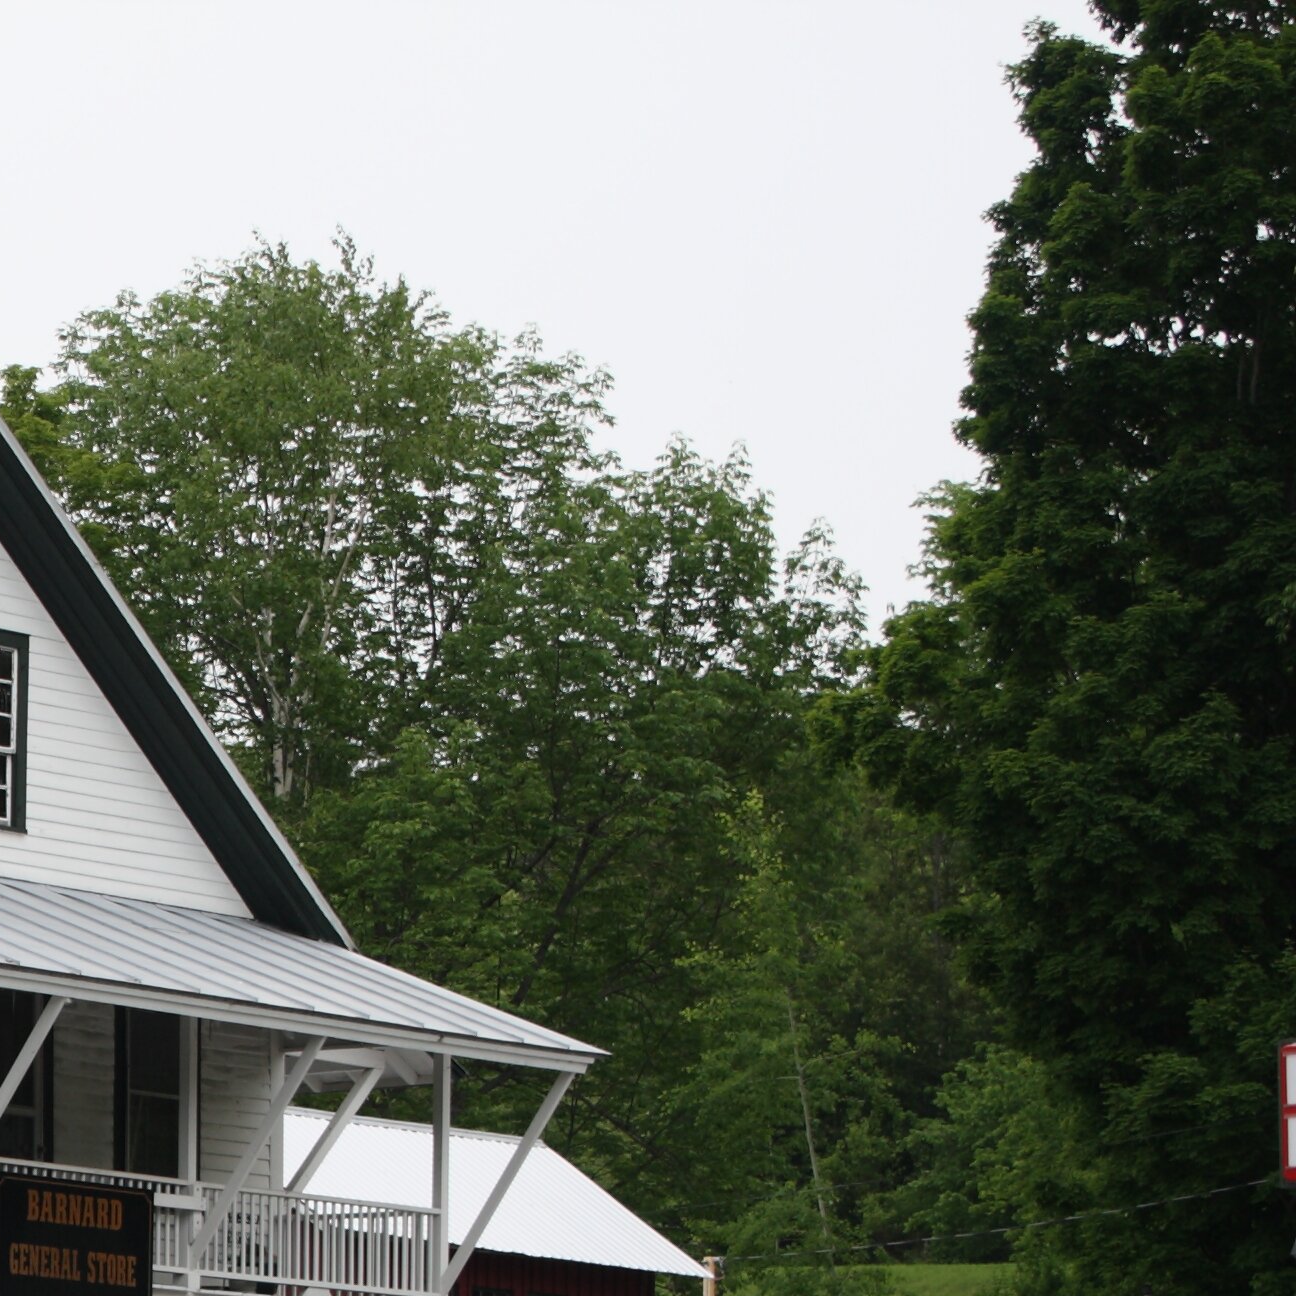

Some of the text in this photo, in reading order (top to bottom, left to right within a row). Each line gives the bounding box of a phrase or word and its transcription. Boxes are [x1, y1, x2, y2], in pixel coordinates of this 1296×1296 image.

[26, 1189, 123, 1231] BARNARD
[9, 1242, 137, 1288] GENERAL STORE
